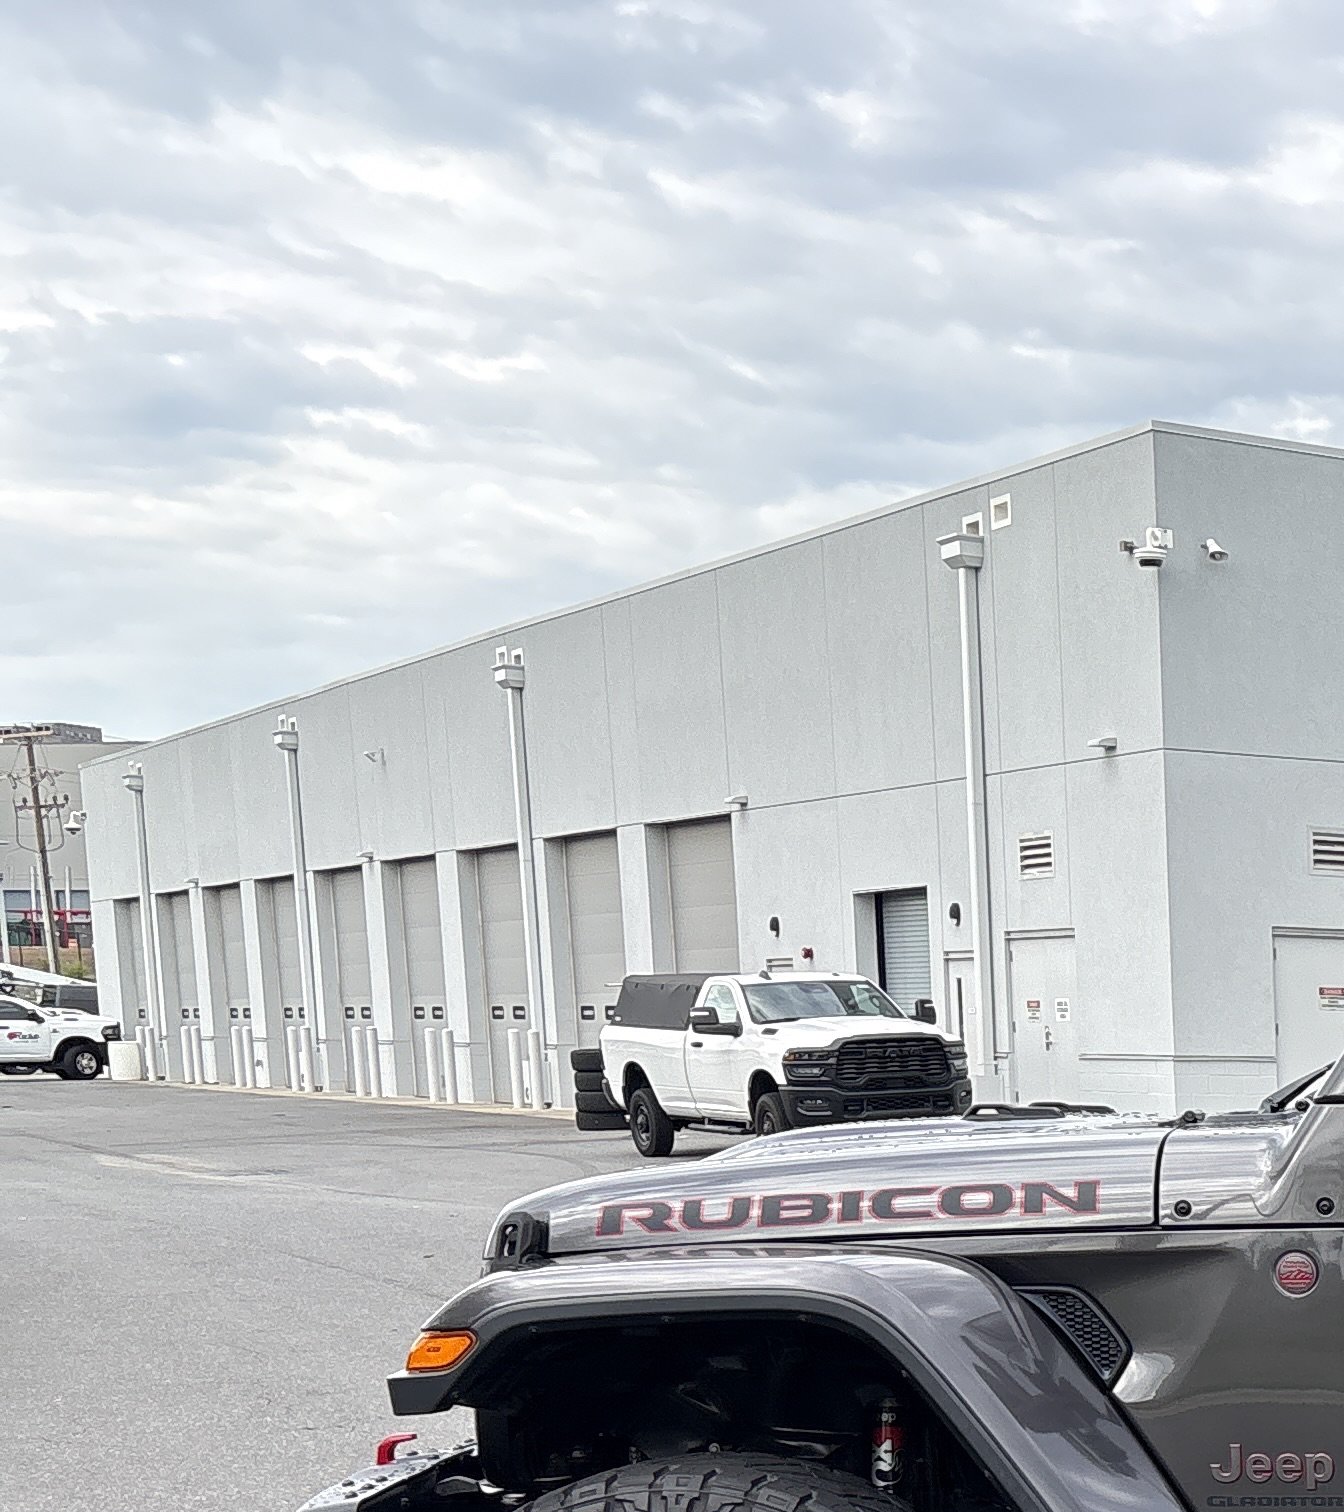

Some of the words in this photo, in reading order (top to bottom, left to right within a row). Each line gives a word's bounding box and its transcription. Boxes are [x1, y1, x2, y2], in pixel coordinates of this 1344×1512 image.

[595, 1179, 1101, 1237] RUBICON
[1210, 1443, 1336, 1491] Jeep
[1206, 1495, 1344, 1508] GLADIATOR
